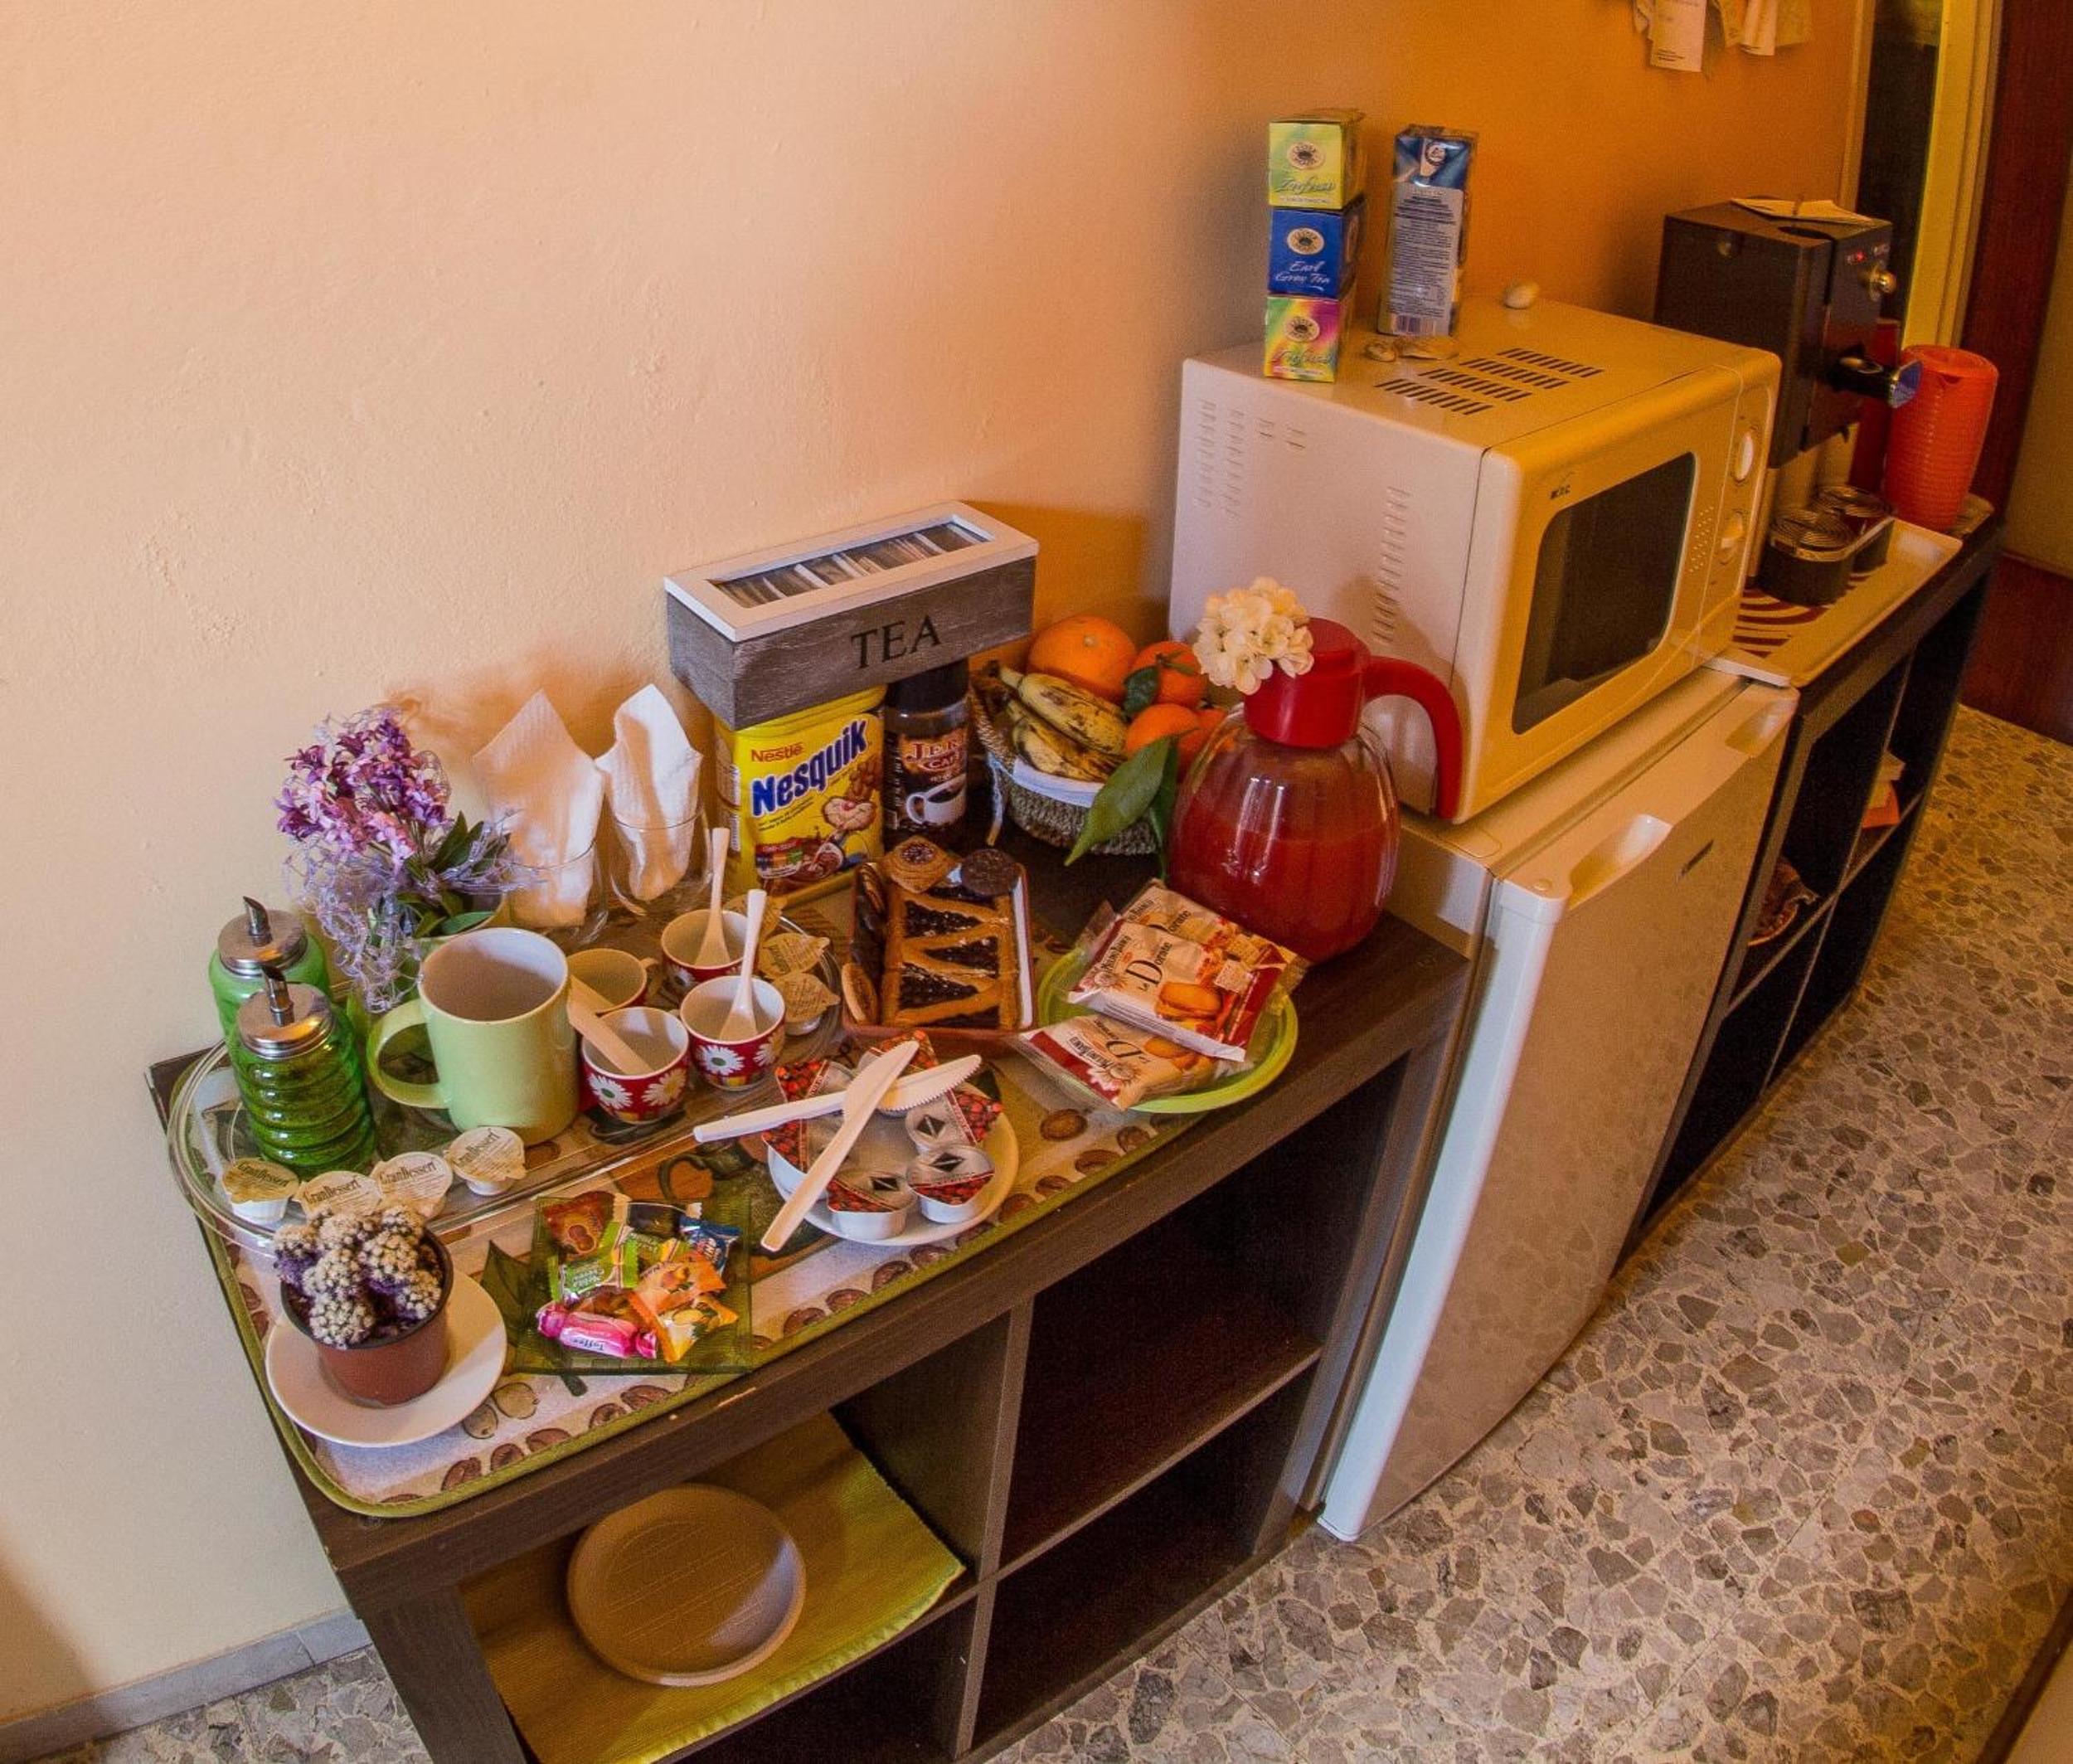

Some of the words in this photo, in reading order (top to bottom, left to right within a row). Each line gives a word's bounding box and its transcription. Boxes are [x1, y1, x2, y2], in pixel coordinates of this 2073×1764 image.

[1275, 272, 1307, 284] Grey
[1310, 274, 1330, 284] Tea
[1289, 260, 1325, 272] Earl
[851, 615, 941, 669] TEA
[752, 719, 867, 817] Nesquik
